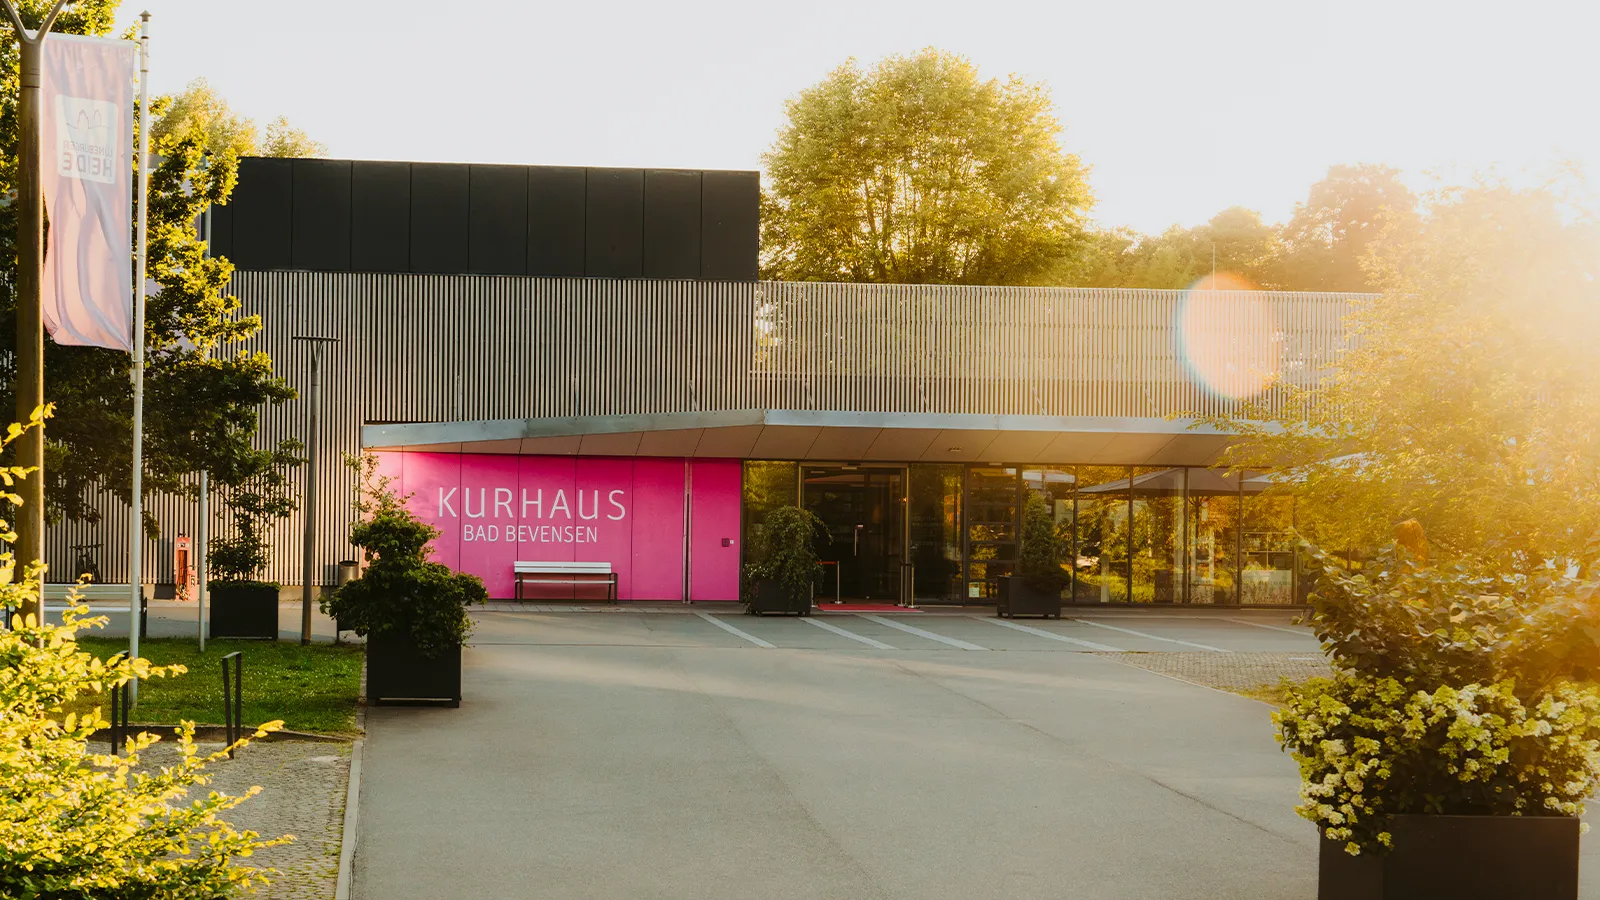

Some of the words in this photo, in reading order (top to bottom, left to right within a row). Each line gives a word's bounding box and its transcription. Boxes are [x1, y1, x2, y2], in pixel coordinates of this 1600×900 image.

[438, 486, 626, 521] KURHAUS
[463, 524, 499, 542] BAD
[505, 525, 598, 543] BEVENSEN
